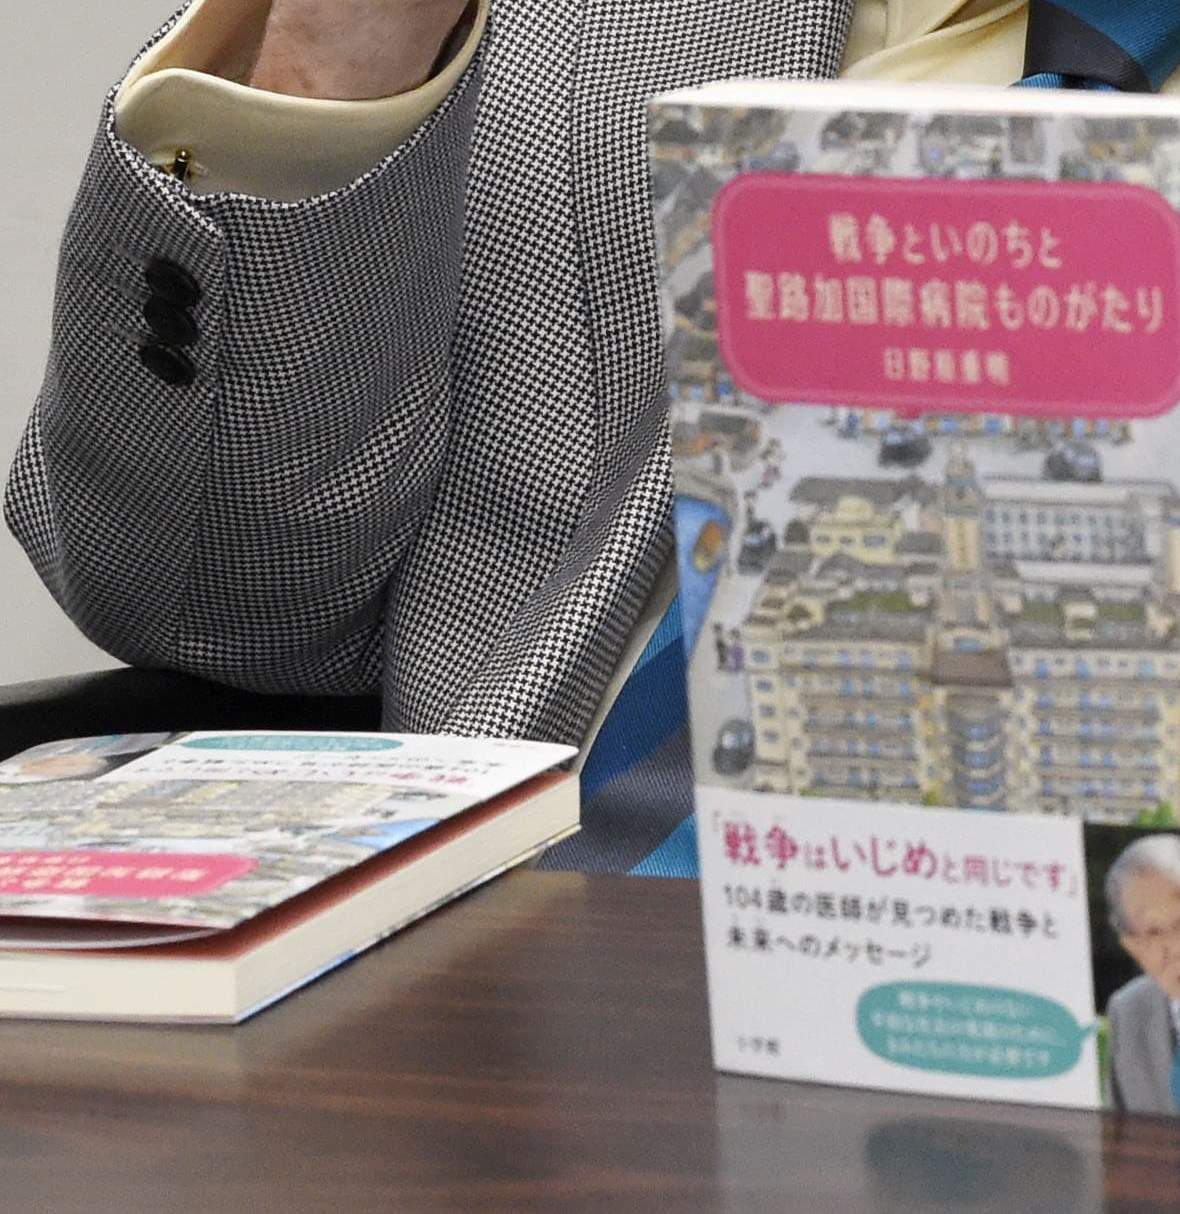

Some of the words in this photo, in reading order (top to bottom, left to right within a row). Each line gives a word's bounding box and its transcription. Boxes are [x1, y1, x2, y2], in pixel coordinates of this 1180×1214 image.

[828, 212, 1063, 269] 戦争といのちと
